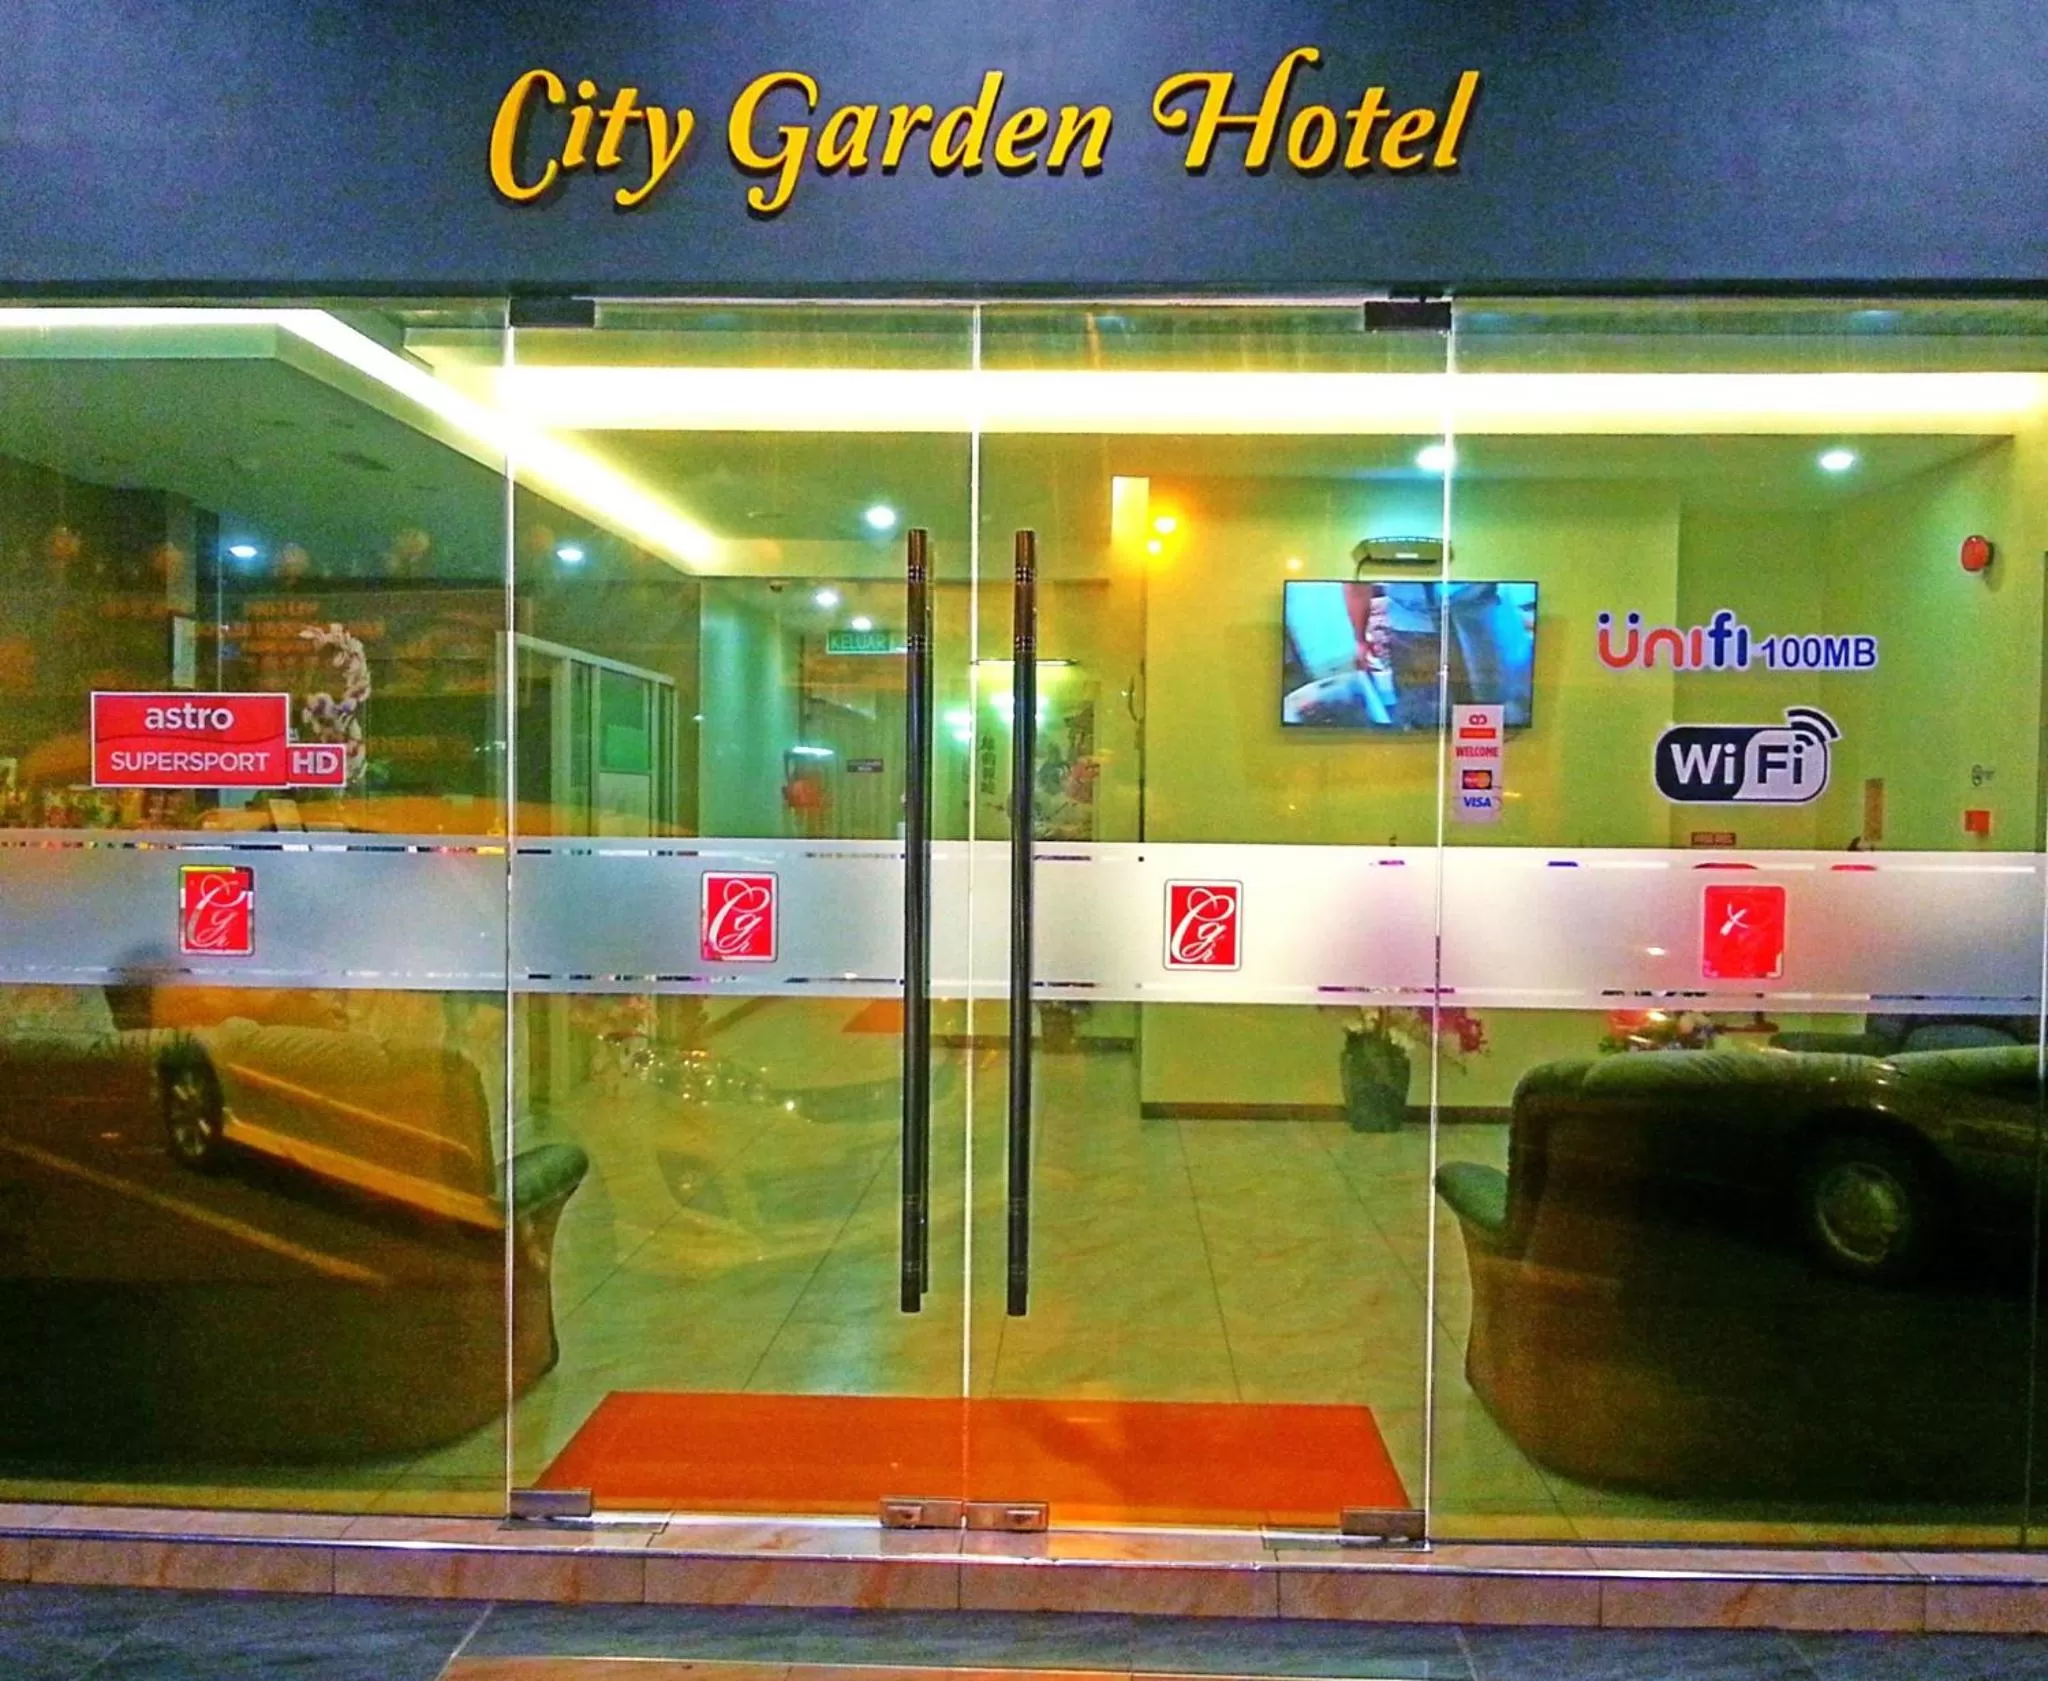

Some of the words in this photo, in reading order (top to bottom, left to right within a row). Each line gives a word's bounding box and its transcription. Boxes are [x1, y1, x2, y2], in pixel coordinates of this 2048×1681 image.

[488, 68, 694, 206] City
[728, 69, 1113, 211] Garden
[1152, 47, 1480, 170] Hotel
[1761, 637, 1876, 668] 100MB
[144, 702, 234, 731] astro
[111, 751, 271, 772] SUPERSPORT
[292, 751, 338, 774] HD
[1455, 746, 1499, 757] WELCOME
[1463, 797, 1492, 808] VISA
